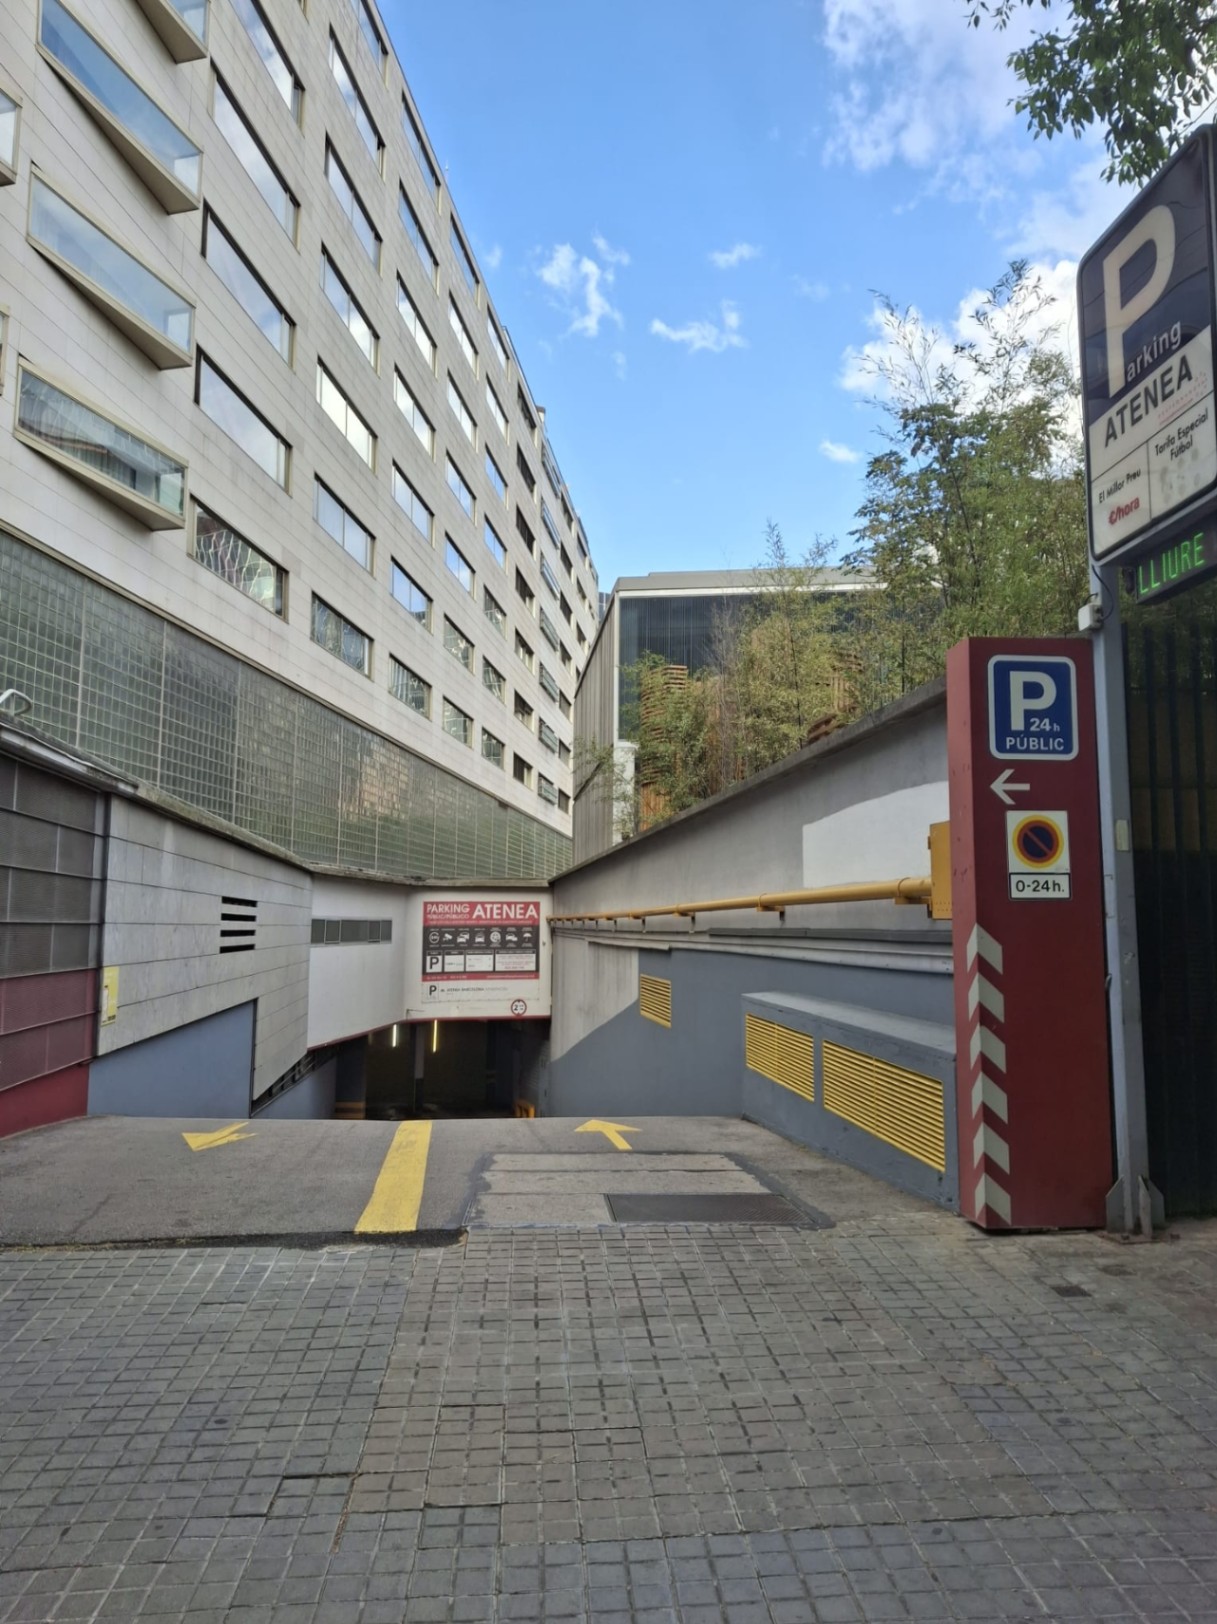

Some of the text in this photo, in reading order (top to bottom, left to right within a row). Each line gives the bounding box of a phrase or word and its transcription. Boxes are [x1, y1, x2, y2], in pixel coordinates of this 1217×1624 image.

[1105, 353, 1193, 448] ATENEA
[1155, 407, 1209, 456] Tarifa Especial
[1098, 469, 1141, 503] El Millor Preu
[1139, 533, 1205, 595] LLIURE
[1009, 671, 1057, 731] P
[1006, 733, 1065, 751] PÚBLIC
[427, 904, 538, 919] PARKING ATENEA
[430, 957, 439, 970] P
[429, 985, 437, 996] P
